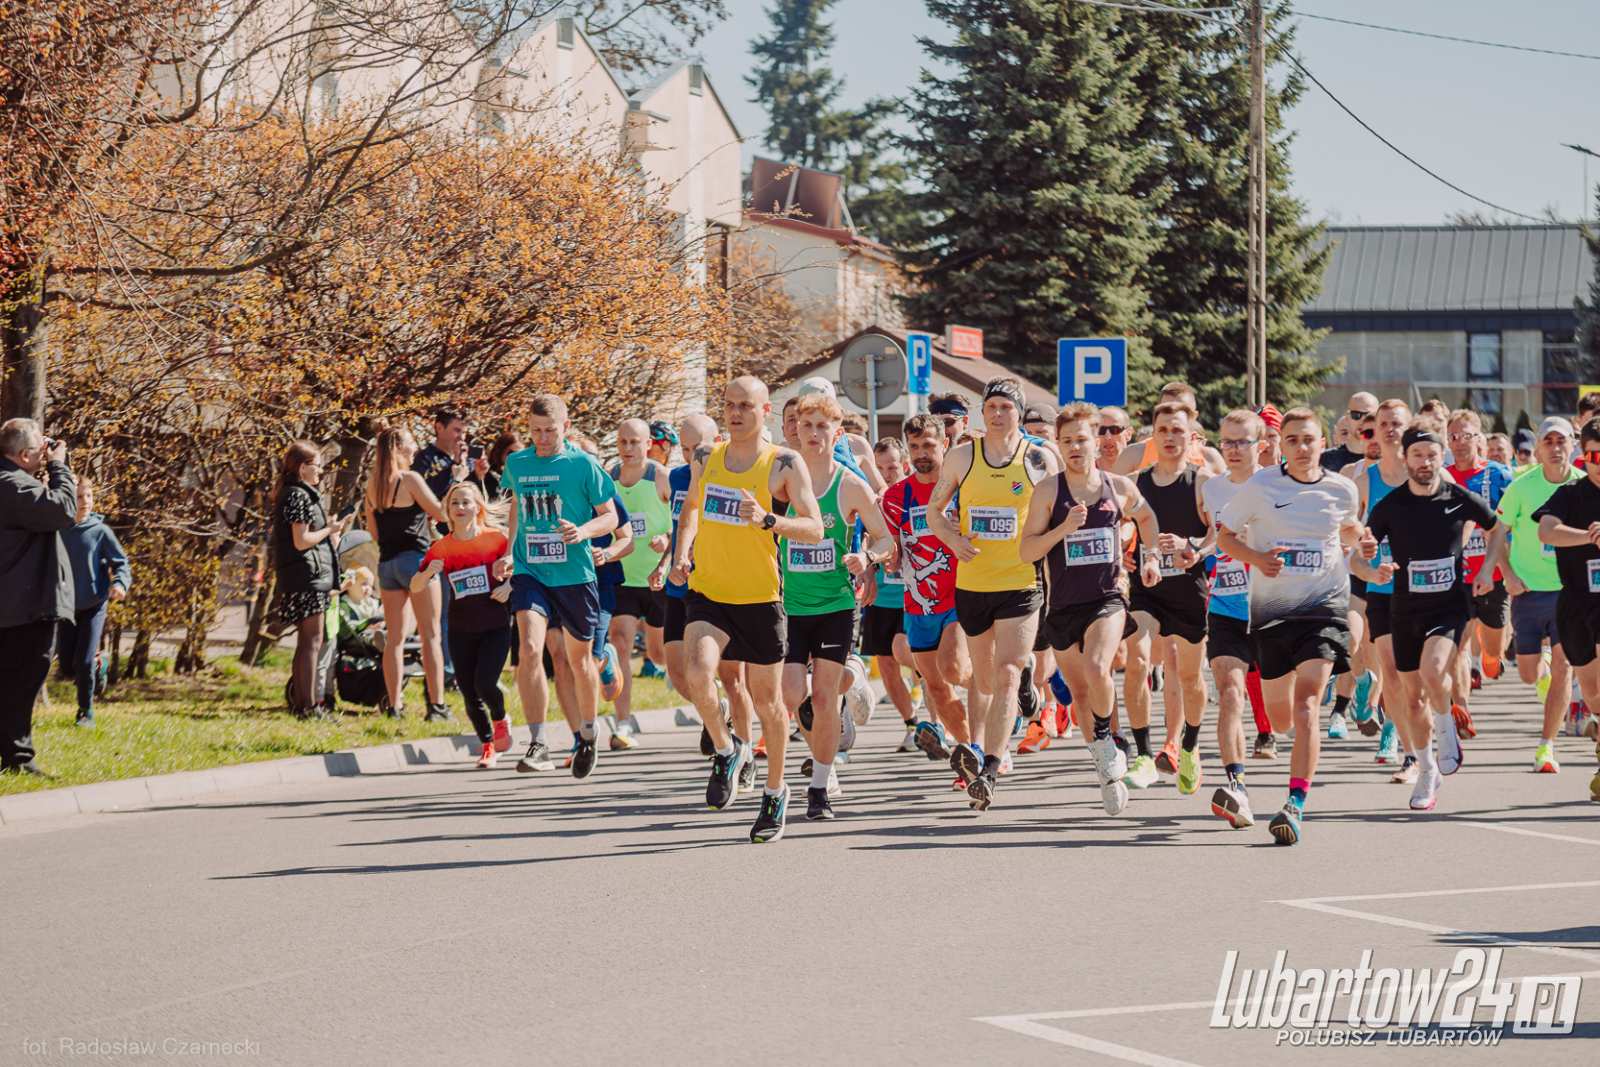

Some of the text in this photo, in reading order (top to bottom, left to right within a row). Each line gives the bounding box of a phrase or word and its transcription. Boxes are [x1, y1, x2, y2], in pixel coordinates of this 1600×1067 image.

[913, 339, 927, 377] P
[1073, 346, 1112, 400] P
[990, 518, 1013, 533] 095
[542, 542, 563, 556] 169
[1087, 539, 1111, 555] 139
[809, 549, 832, 564] 108
[1295, 551, 1321, 567] 080
[1222, 572, 1245, 587] 138
[1430, 569, 1452, 584] 123
